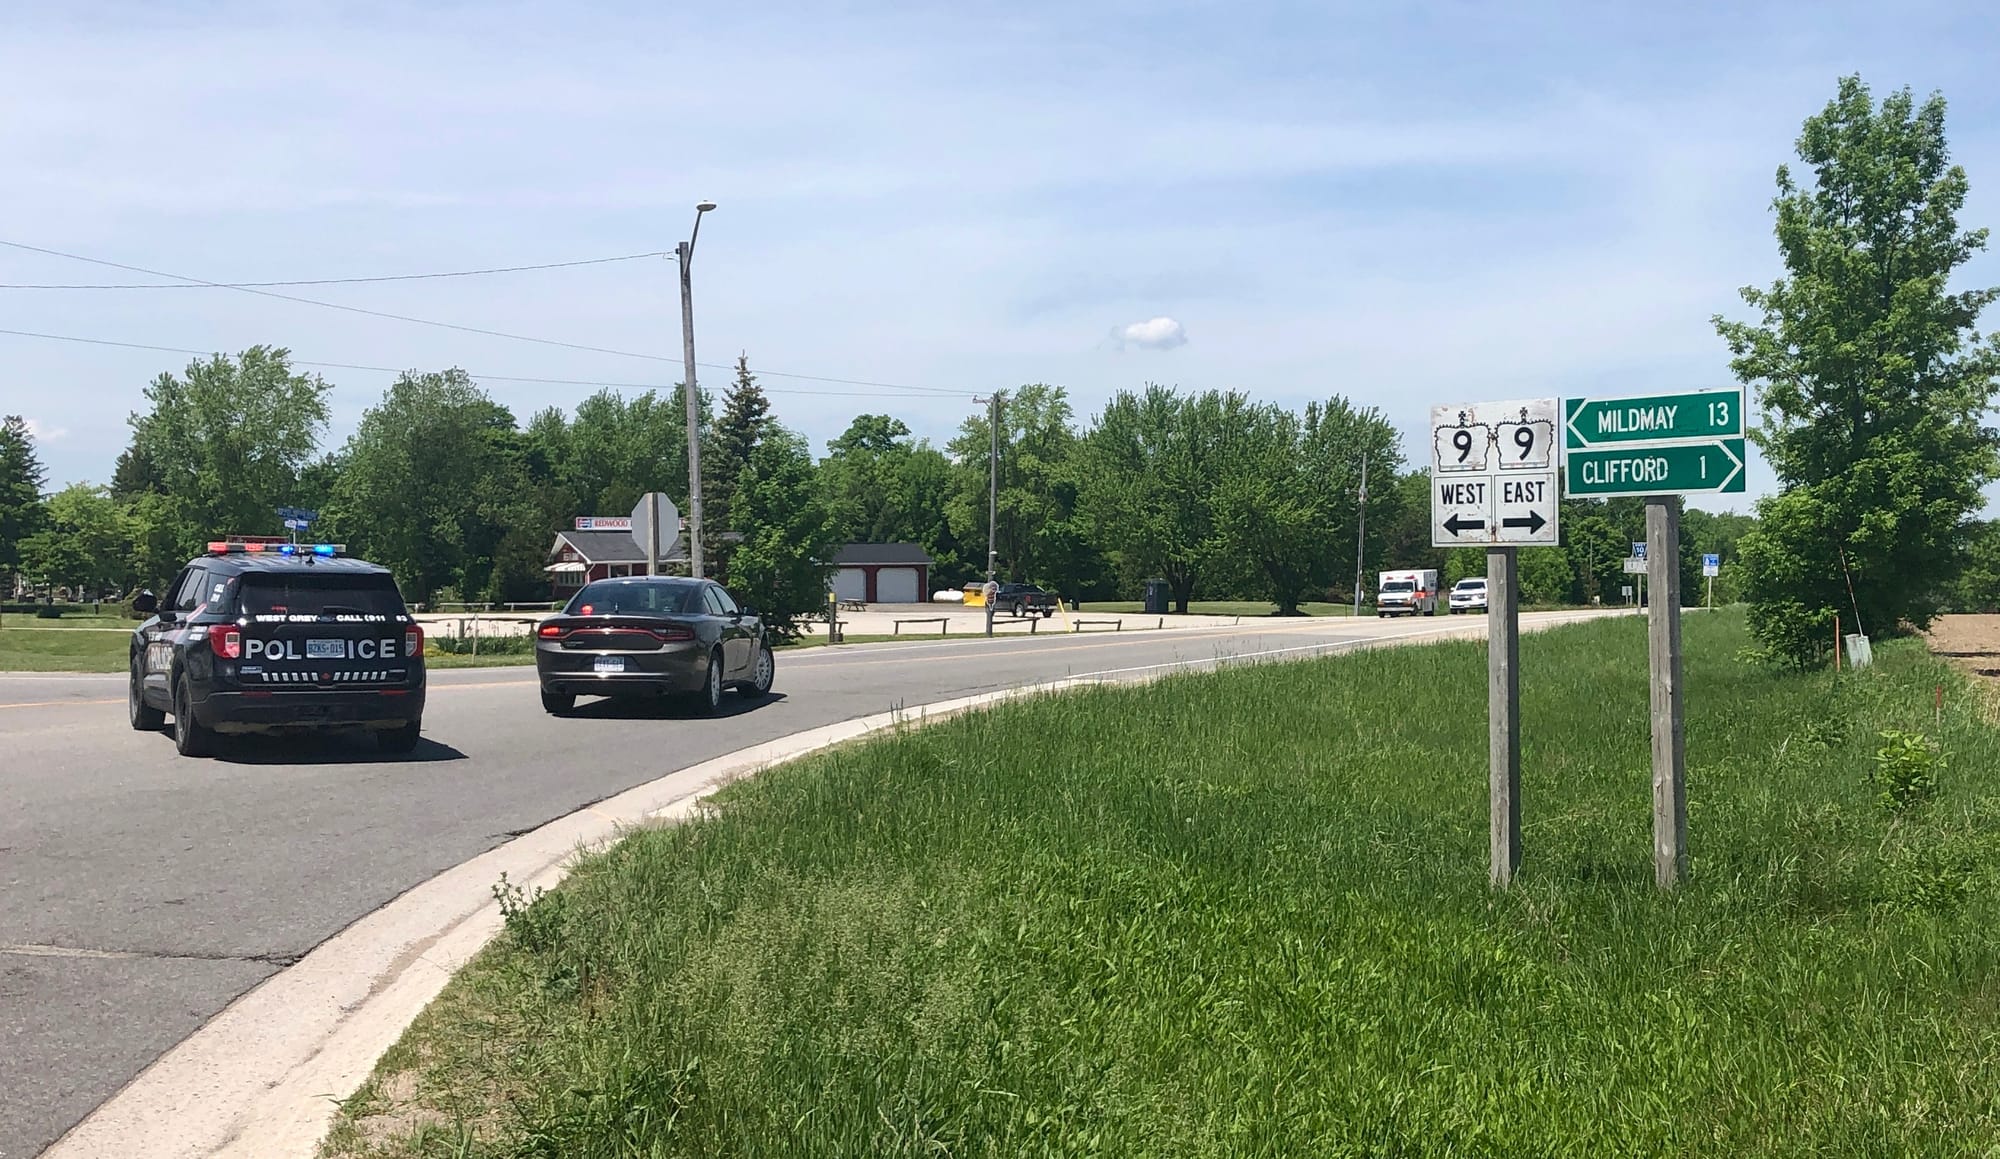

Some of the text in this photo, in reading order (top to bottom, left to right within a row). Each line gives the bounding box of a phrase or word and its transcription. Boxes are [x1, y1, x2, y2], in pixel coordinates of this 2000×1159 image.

[1597, 401, 1729, 433] MILDMAY 13
[1453, 430, 1472, 463] 9
[1514, 427, 1534, 460] 9
[1582, 455, 1706, 484] CLIFFORD 1
[1441, 483, 1485, 505] WEST
[1504, 481, 1545, 503] EAST
[594, 519, 628, 528] REDWOOD
[255, 614, 286, 622] WEST
[288, 614, 318, 622] GREY
[336, 614, 363, 622] CALL
